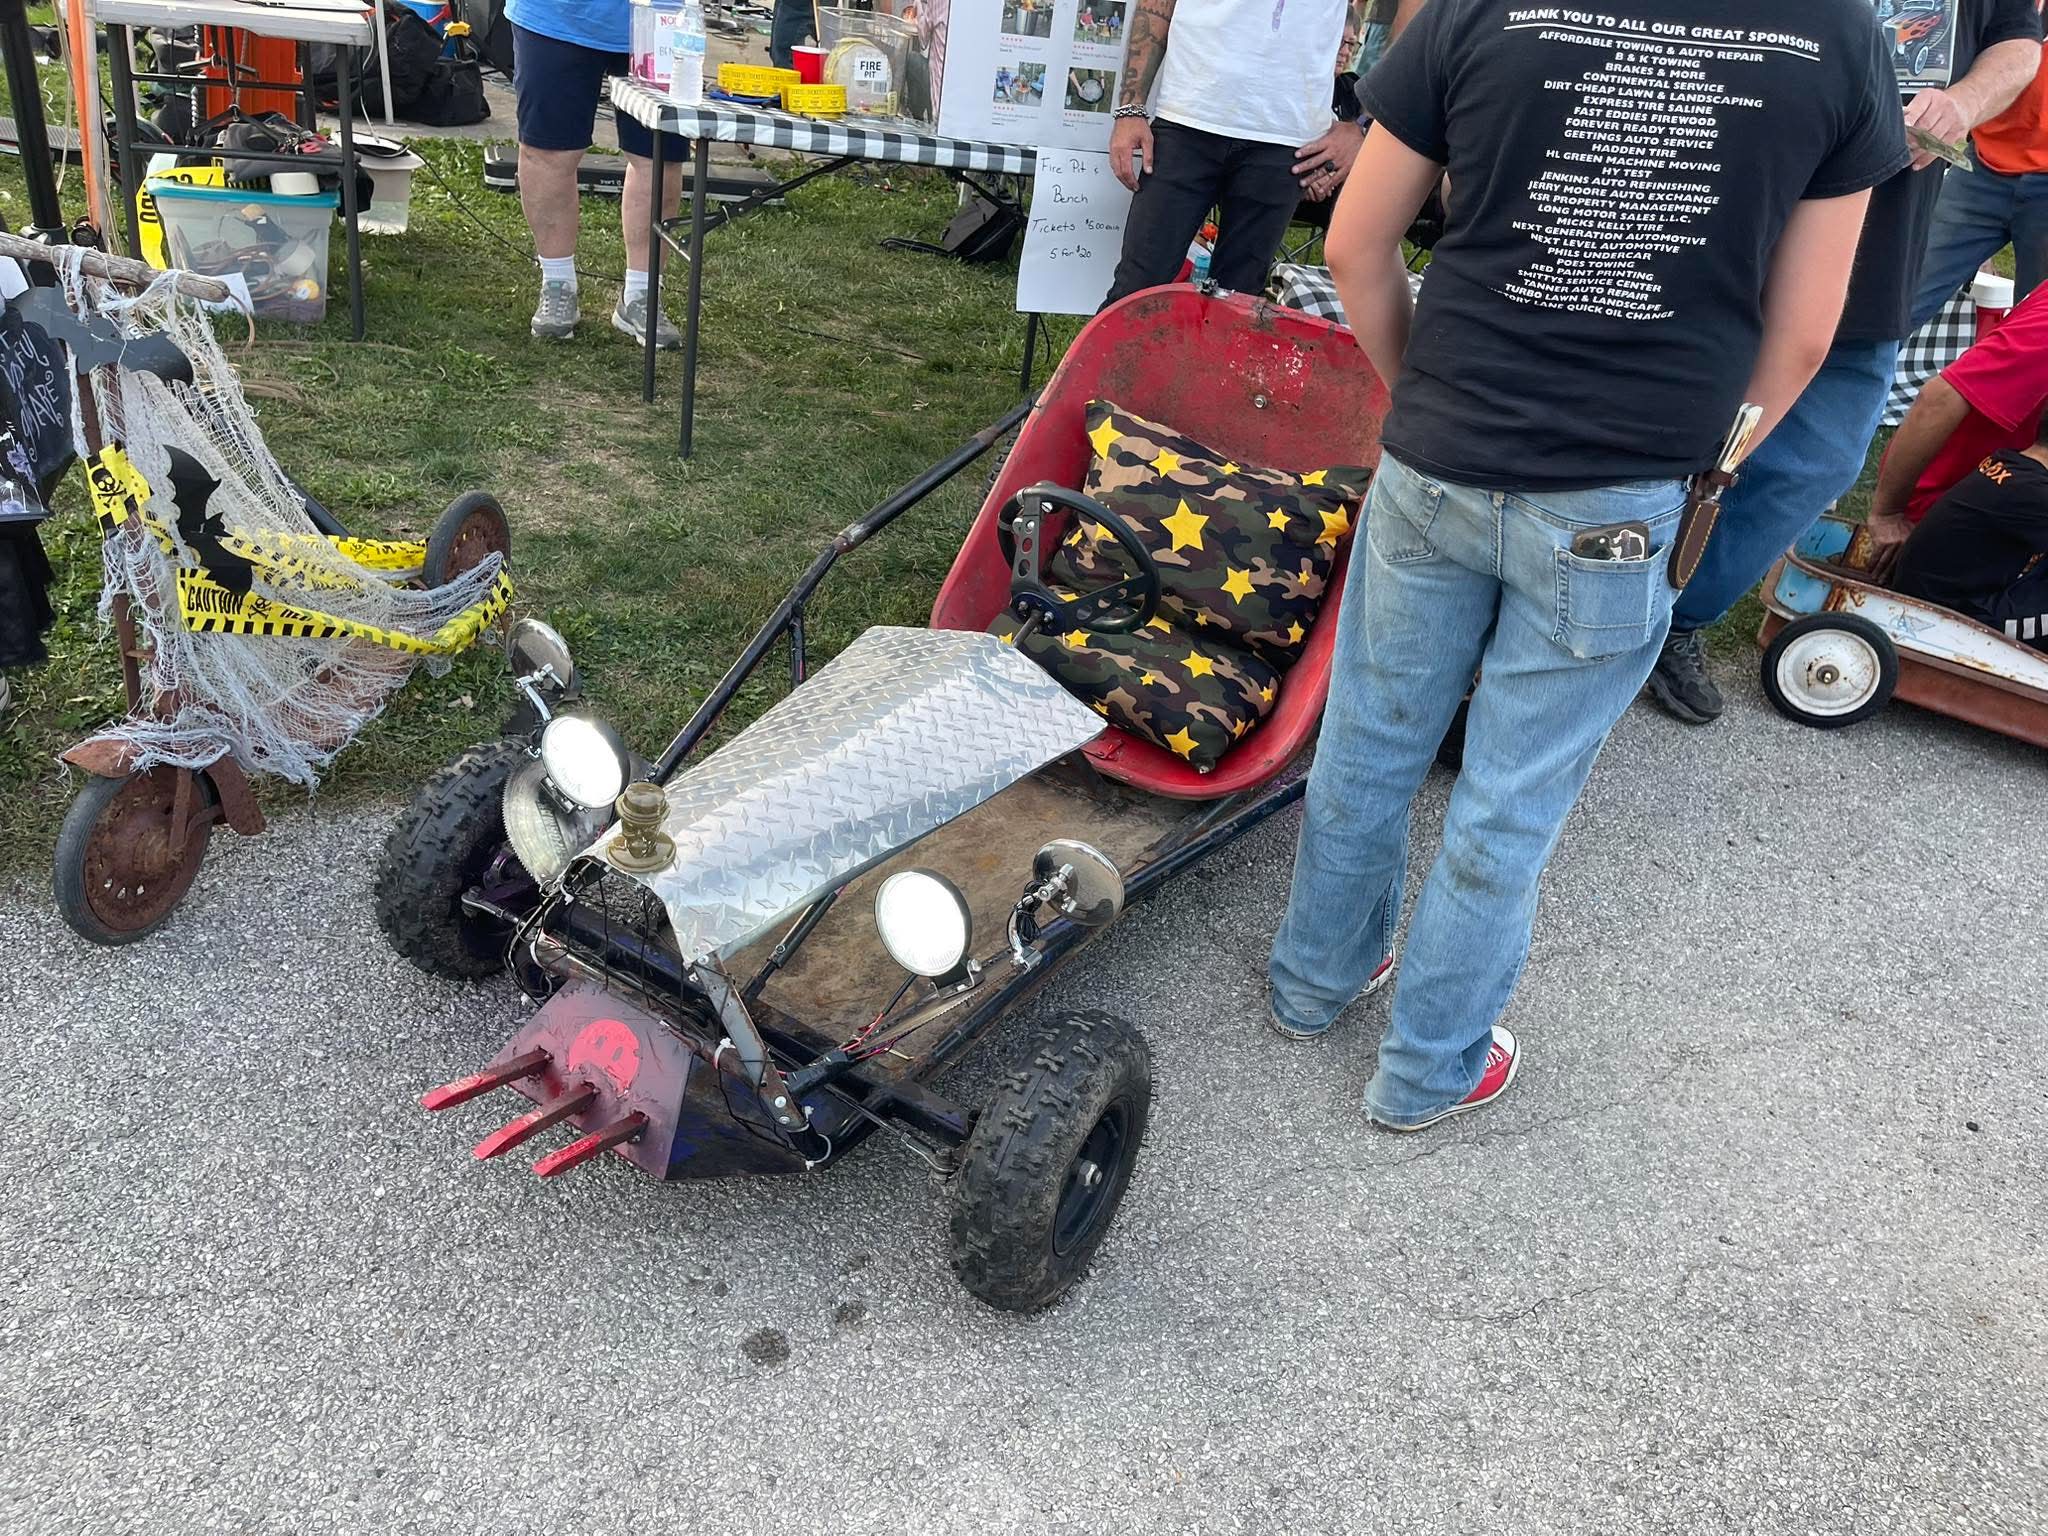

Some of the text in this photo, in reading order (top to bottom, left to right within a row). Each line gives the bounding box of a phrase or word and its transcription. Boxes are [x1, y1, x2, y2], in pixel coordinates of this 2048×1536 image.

[1509, 9, 1819, 53] THANK YOU TO ALL OUR GREAT SPONSORS
[1539, 31, 1763, 61] AFFORDABLE TOWING & AUTO REPAIR
[860, 60, 882, 71] FIRE
[1615, 52, 1623, 60] B
[1639, 55, 1649, 63] K
[1651, 56, 1700, 68] TOWING
[864, 70, 876, 79] PIT
[1605, 63, 1654, 75] BRAKES
[1670, 70, 1705, 80] MORE
[1583, 72, 1724, 92] CONTINENTAL SERVICE
[1544, 80, 1762, 107] DIRT CHEAP LAWN & LANDSCAPING
[1583, 96, 1713, 114] EXPRESS TIRE SALINE
[1574, 107, 1716, 126] FAST EDDIES FIREWOOD
[1566, 118, 1718, 138] FOREVER READY TOWING
[1565, 130, 1714, 149] GEETINGS AUTO SERVICE
[1592, 144, 1677, 157] HADDEN TIRE
[1040, 157, 1063, 174] Fire
[1069, 158, 1086, 173] Pit
[1546, 150, 1721, 172] HL GREEN MACHINE MOVING
[1541, 171, 1710, 193] JENKINS AUTO REFINISHING
[1602, 167, 1652, 178] HY TEST
[1051, 184, 1089, 204] Bench
[1528, 181, 1719, 204] JERRY MOORE AUTO EXCHANGE
[1530, 192, 1711, 214] KSR PROPERTY MANAGEMENT
[1538, 204, 1569, 214] LONG
[1573, 208, 1616, 219] MOTOR
[1620, 213, 1656, 221] SALES
[1032, 217, 1076, 233] Tickets
[1512, 221, 1706, 245] NEXT GENERATION AUTOMOTIVE
[1557, 217, 1594, 228] MICKS
[1600, 221, 1633, 230] KELLY
[1531, 233, 1680, 253] NEXT LEVEL AUTOMOTIVE
[1049, 247, 1058, 260] 5
[1548, 247, 1651, 260] PHILS UNDERCAR
[1557, 258, 1585, 267] POES
[1518, 270, 1563, 283] SMITTYS
[1616, 280, 1661, 292] CENTER
[1531, 264, 1654, 281] RED PAINT PRINTING
[1506, 284, 1542, 298] TURBO
[1593, 296, 1661, 311] LANDSCAPE
[1524, 279, 1568, 292] TANNER
[1607, 288, 1648, 301] REPAIR
[1567, 304, 1603, 313] QUICK
[1605, 309, 1622, 317] OIL
[1626, 311, 1674, 320] CHANGE
[187, 585, 244, 615] CAUTION
